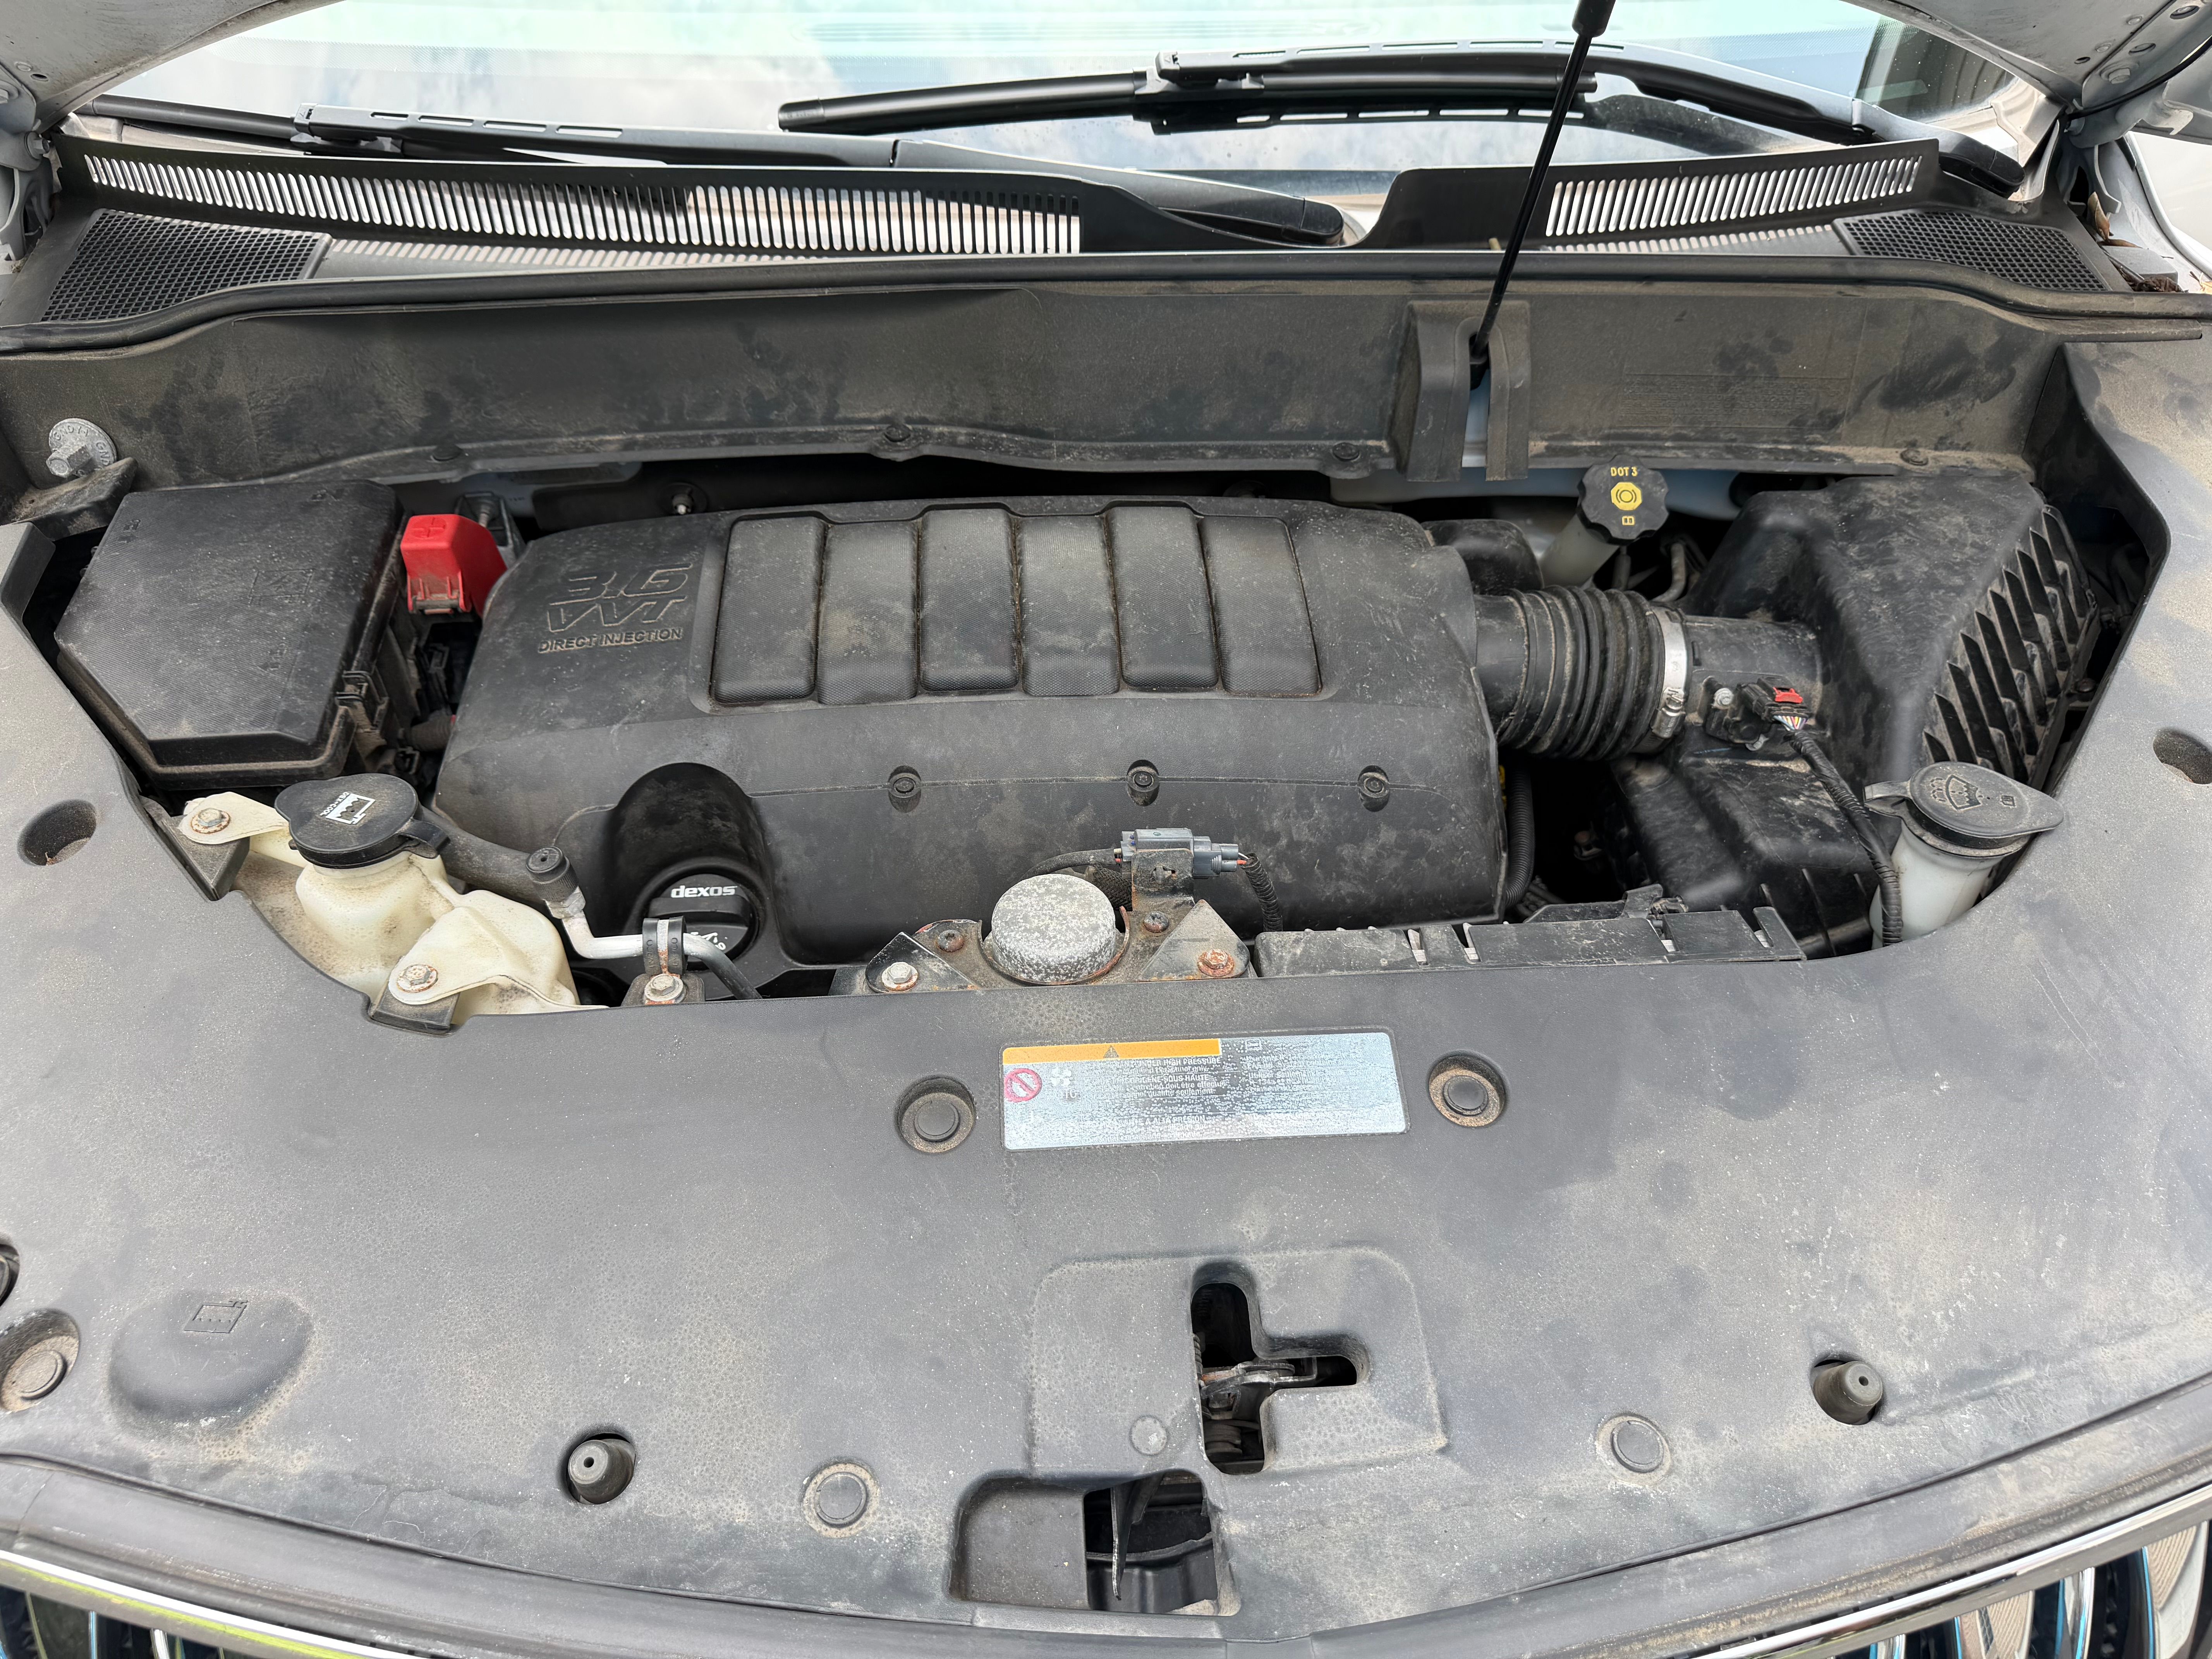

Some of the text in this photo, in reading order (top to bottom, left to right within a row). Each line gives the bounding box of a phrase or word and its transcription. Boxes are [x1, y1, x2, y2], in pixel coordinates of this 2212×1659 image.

[1611, 467, 1638, 476] DOT 3
[549, 563, 693, 606] 3.6
[546, 595, 687, 633] VVT
[538, 627, 683, 654] DIRECT INJECTION
[319, 791, 351, 816] DEX-COOL
[671, 885, 738, 898] dexos
[1183, 1057, 1221, 1065] PRESSURE
[1164, 1075, 1183, 1083] SOUS
